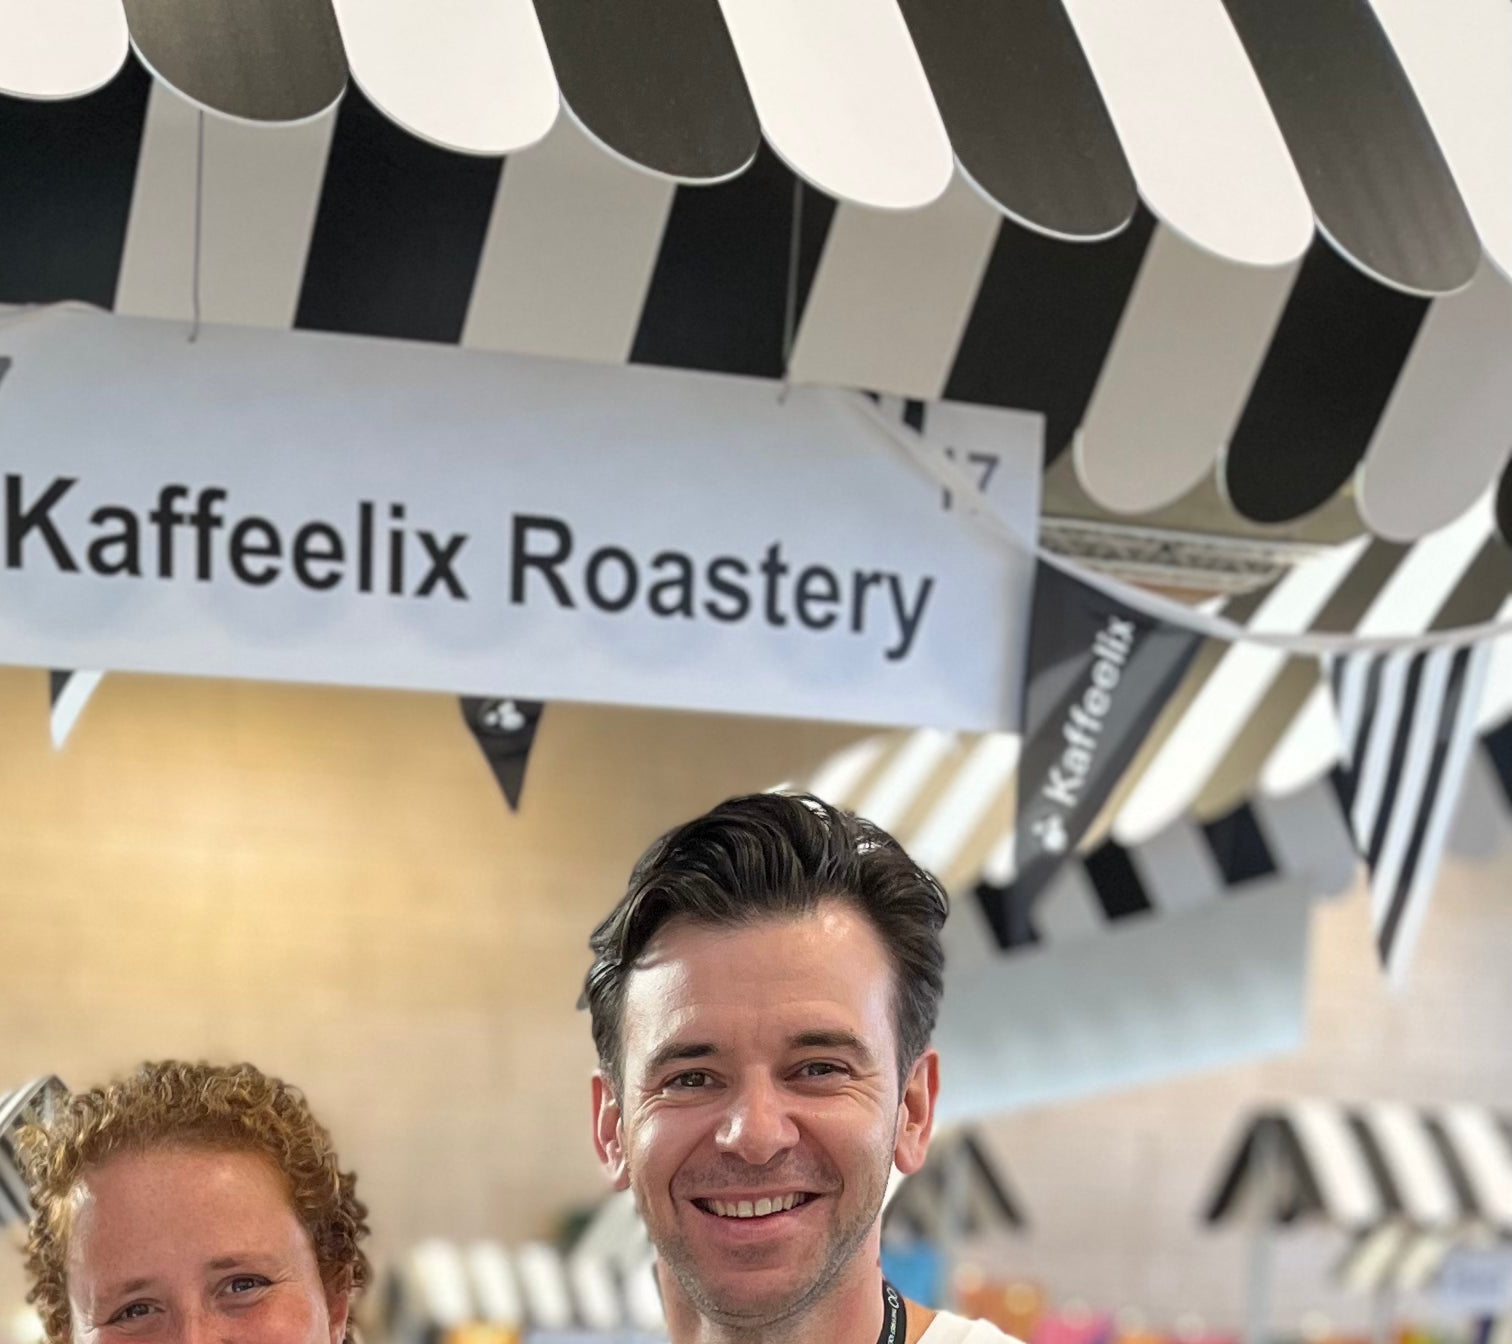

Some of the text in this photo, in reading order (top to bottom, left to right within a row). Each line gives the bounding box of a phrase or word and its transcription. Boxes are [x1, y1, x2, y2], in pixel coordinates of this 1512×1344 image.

[3, 473, 935, 662] Kaffeelix Roastery
[1042, 615, 1135, 808] Kaffeelix
[884, 1286, 900, 1308] 00
